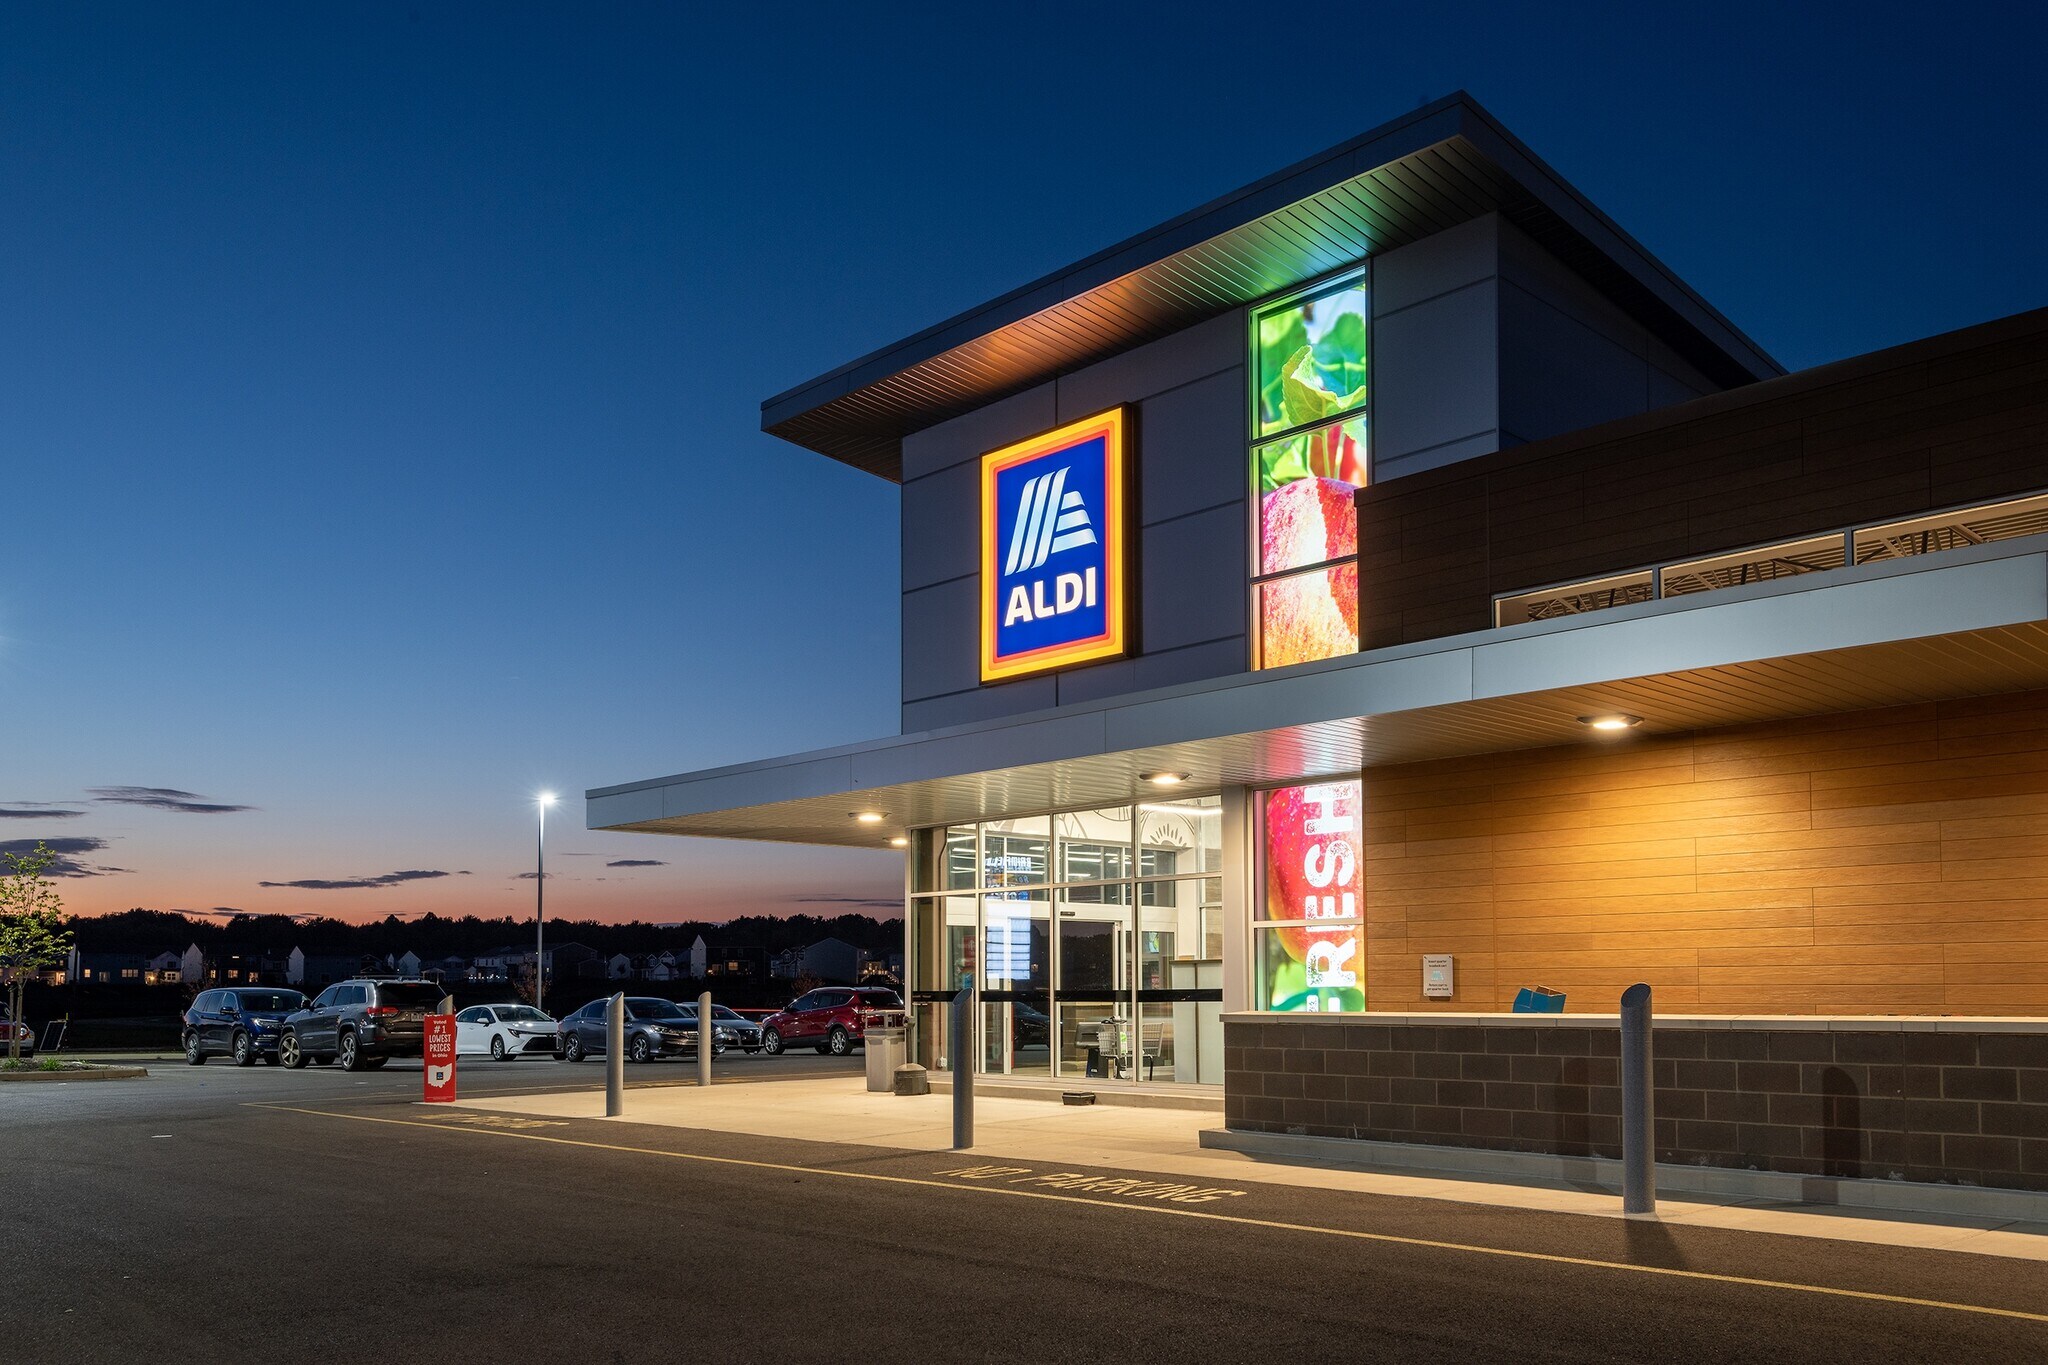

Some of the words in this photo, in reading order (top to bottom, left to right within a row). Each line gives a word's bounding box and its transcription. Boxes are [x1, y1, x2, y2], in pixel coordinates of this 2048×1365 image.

[1004, 566, 1097, 627] ALDI
[428, 1034, 451, 1043] LOWEST
[429, 1043, 451, 1052] PRICES
[932, 1165, 1033, 1179] NO
[1008, 1172, 1248, 1203] PARKING
